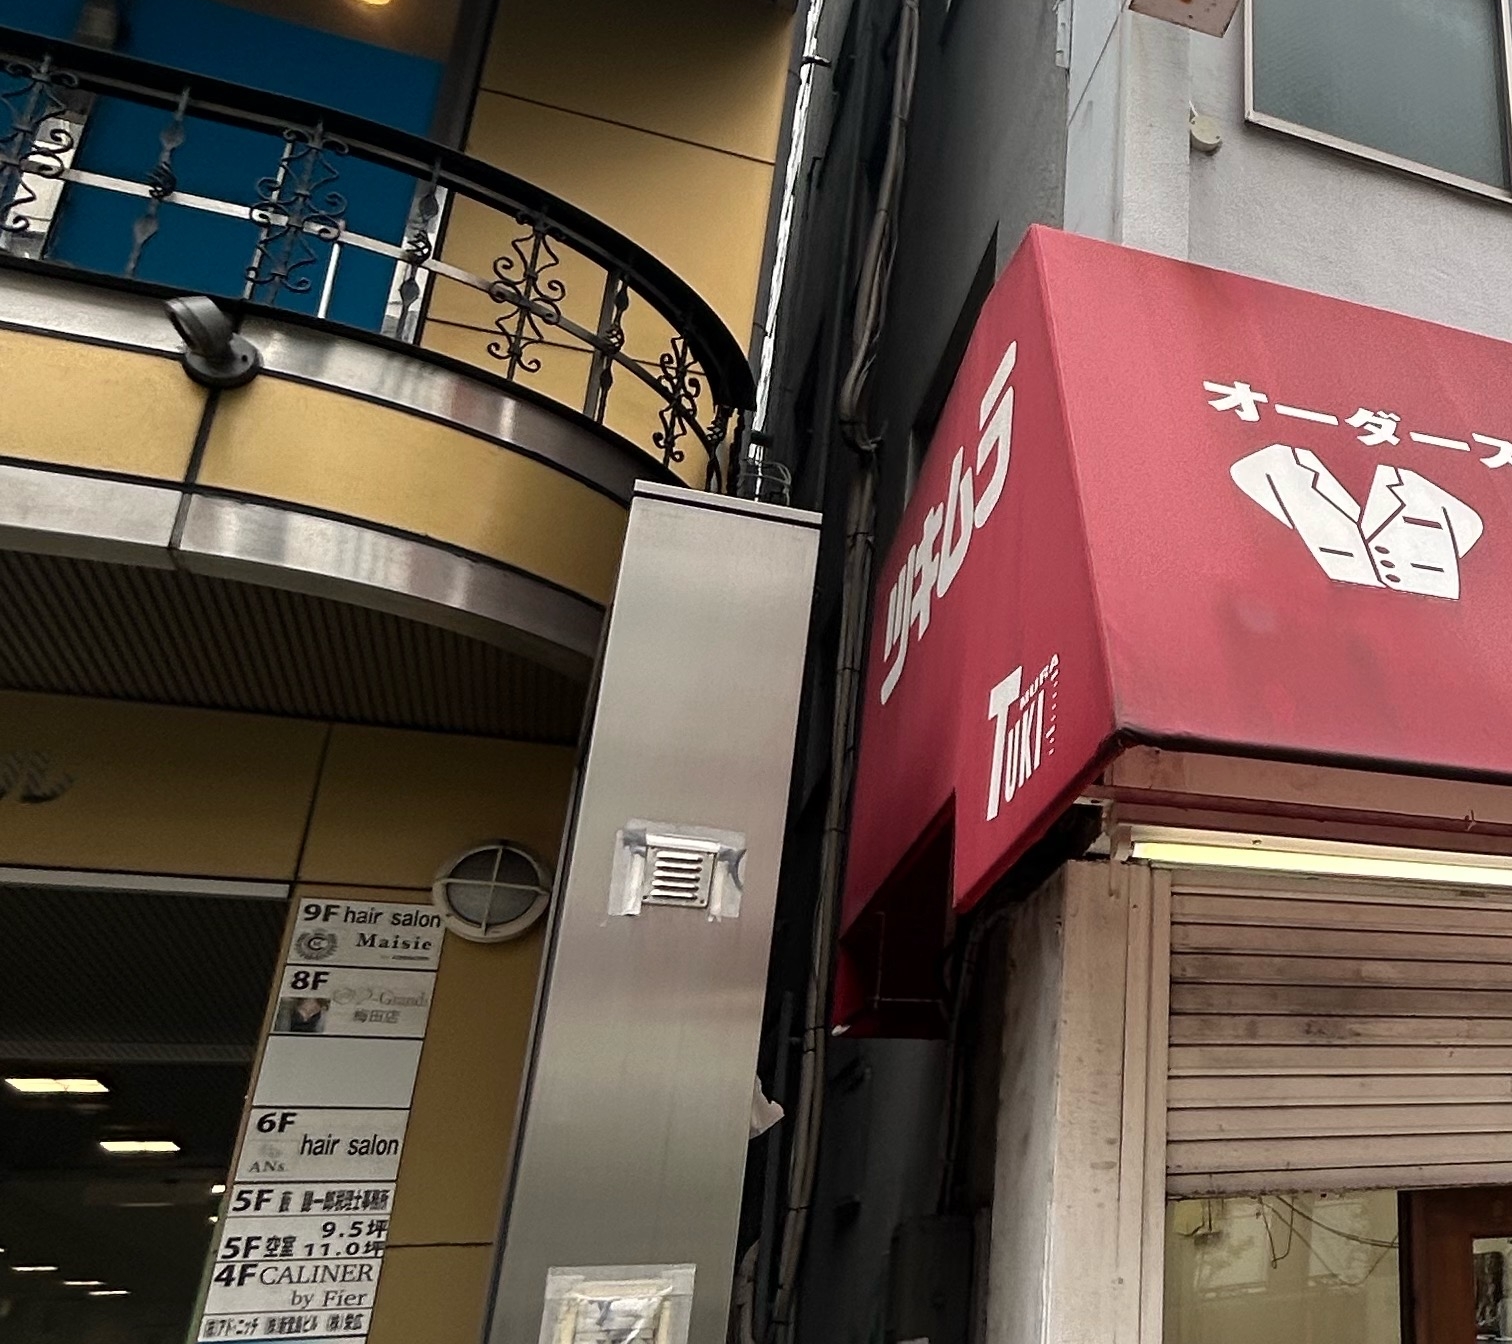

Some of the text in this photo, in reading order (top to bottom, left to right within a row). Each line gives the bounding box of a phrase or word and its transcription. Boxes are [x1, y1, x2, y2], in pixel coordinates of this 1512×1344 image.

[881, 340, 1018, 706] ツキムラ
[304, 904, 441, 928] 9F hair salon
[356, 933, 432, 951] Maisie
[291, 971, 330, 991] 8F
[257, 1113, 297, 1133] 6F
[300, 1134, 399, 1155] hair salon
[232, 1189, 274, 1212] 5F
[221, 1236, 262, 1259] 5F
[263, 1235, 297, 1257] 空室
[214, 1263, 373, 1287] 4F CALINER
[291, 1290, 369, 1309] by Fier
